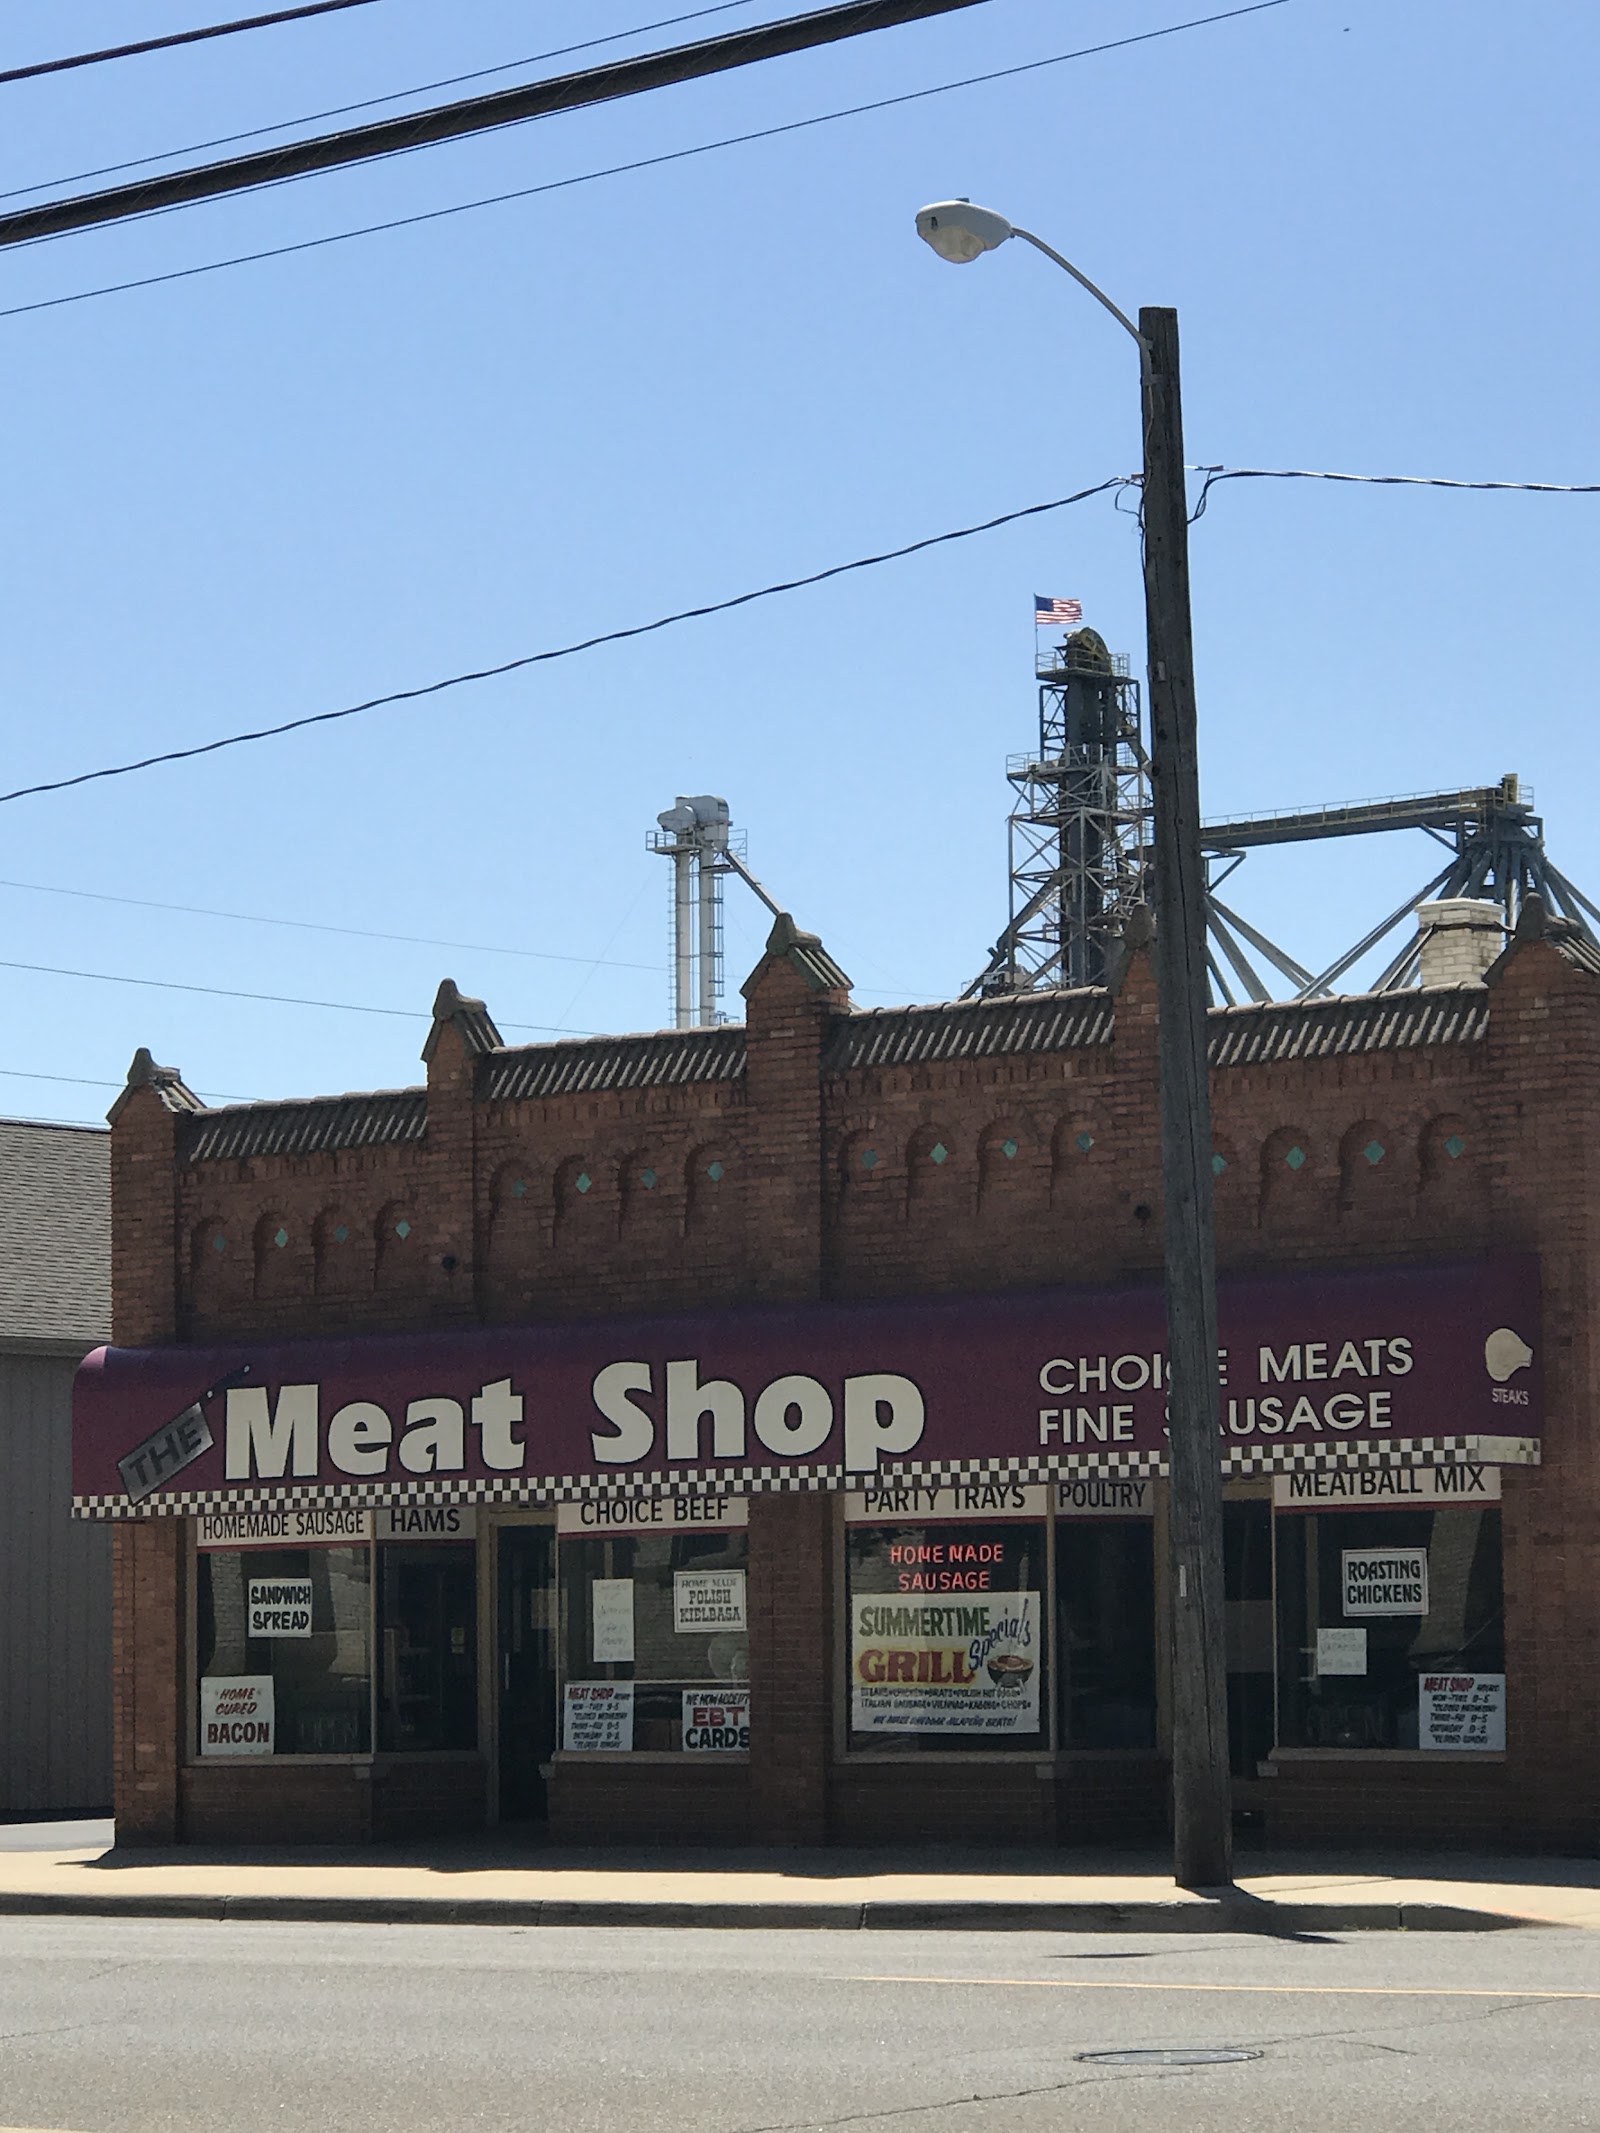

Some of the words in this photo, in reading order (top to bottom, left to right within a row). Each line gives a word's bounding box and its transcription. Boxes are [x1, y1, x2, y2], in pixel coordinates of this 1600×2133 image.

[1038, 1349, 1227, 1395] CHOI
[1259, 1336, 1415, 1384] MEATS
[1492, 1388, 1529, 1405] STEAKS
[225, 1377, 526, 1481] Meat
[591, 1358, 926, 1473] Shop
[1040, 1407, 1134, 1446] FINE
[1163, 1391, 1392, 1438] USAGE
[127, 1417, 203, 1488] THE
[1289, 1468, 1423, 1497] MEATBALL
[1434, 1465, 1486, 1493] MIX
[864, 1487, 939, 1513] PARTY
[953, 1485, 1026, 1510] TRAYS
[1059, 1482, 1146, 1508] POULTRY
[390, 1508, 461, 1533] HAMS
[580, 1499, 663, 1525] CHOICE
[673, 1497, 728, 1521] BEEF
[203, 1513, 290, 1540] HOMEMADE
[296, 1511, 364, 1537] SAUSAGE
[890, 1544, 945, 1565] HOME
[948, 1543, 1004, 1564] MADE
[898, 1570, 991, 1592] SAUSAGE
[1347, 1560, 1420, 1582] ROASTING
[681, 1579, 708, 1588] HOME
[1347, 1584, 1422, 1604] CHICKENS
[251, 1586, 311, 1605] SANDWICH
[689, 1590, 732, 1605] POLISH
[253, 1611, 310, 1630] SPREAD
[680, 1606, 742, 1623] KIELBASA
[859, 1606, 991, 1637] SUMMERTIME
[968, 1598, 1032, 1671] Specials
[859, 1649, 975, 1683] GRILL
[219, 1688, 256, 1701] HOME
[568, 1687, 591, 1701] MEAT
[591, 1687, 615, 1701] SHOP
[1423, 1677, 1451, 1692] MEAT
[1450, 1677, 1475, 1692] SHOP
[215, 1702, 258, 1715] CURED
[685, 1694, 698, 1706] WE
[698, 1694, 718, 1706] NOW
[692, 1706, 746, 1727] EBT
[207, 1722, 270, 1744] BACON
[685, 1726, 750, 1750] CARDS
